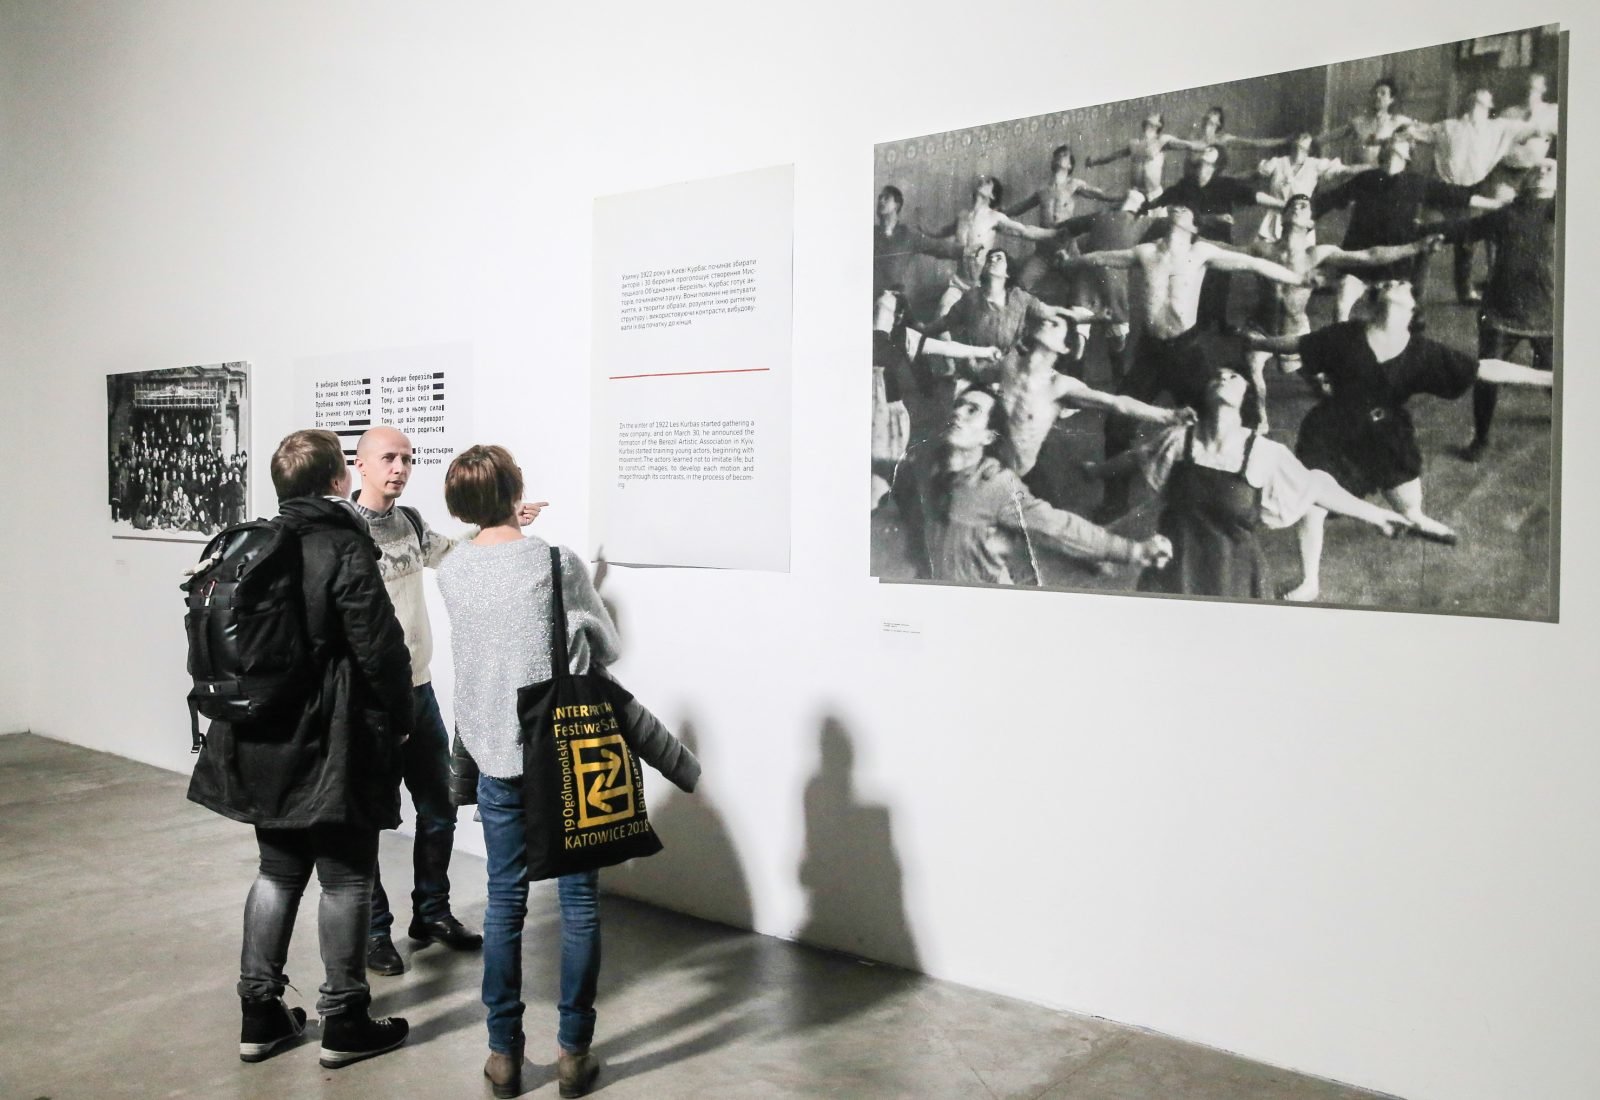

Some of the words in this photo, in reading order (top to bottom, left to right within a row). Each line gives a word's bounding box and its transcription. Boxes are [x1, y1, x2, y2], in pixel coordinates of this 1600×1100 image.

[722, 420, 749, 428] gathering
[653, 447, 674, 456] training
[675, 448, 691, 456] young
[713, 447, 740, 456] beginning
[679, 465, 701, 473] develop
[632, 473, 650, 482] through
[660, 473, 685, 481] contrasts,
[703, 474, 724, 482] process
[557, 739, 576, 819] Ogólnopolski
[565, 821, 576, 833] 19
[565, 824, 625, 850] KATOWICE
[627, 819, 650, 836] 2018
